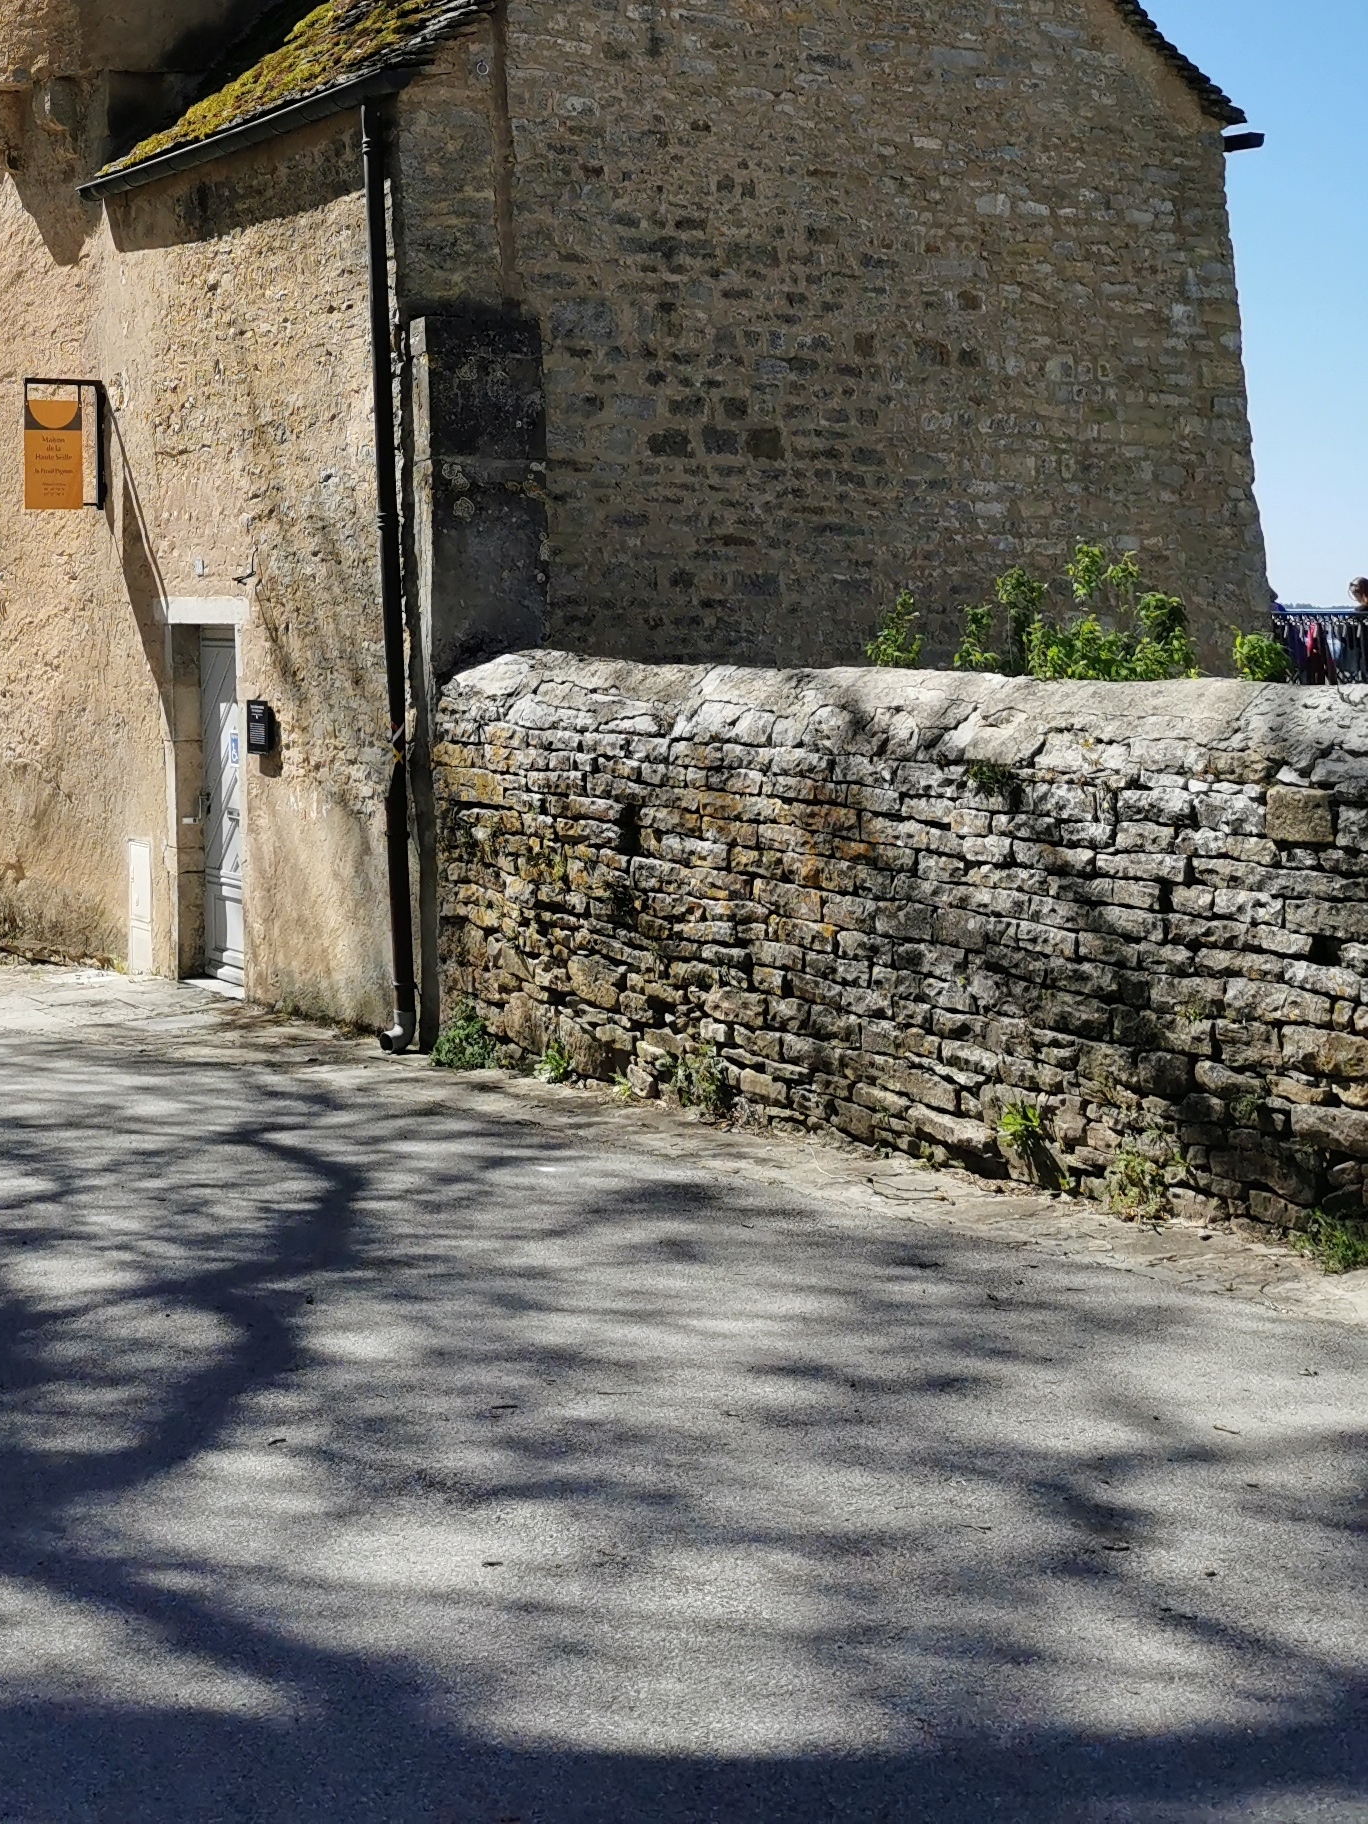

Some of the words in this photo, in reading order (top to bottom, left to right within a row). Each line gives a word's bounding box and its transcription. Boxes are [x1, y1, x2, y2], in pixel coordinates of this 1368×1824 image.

[41, 435, 66, 444] Maison
[46, 444, 54, 452] de
[55, 444, 62, 452] la
[35, 453, 55, 461] Haute
